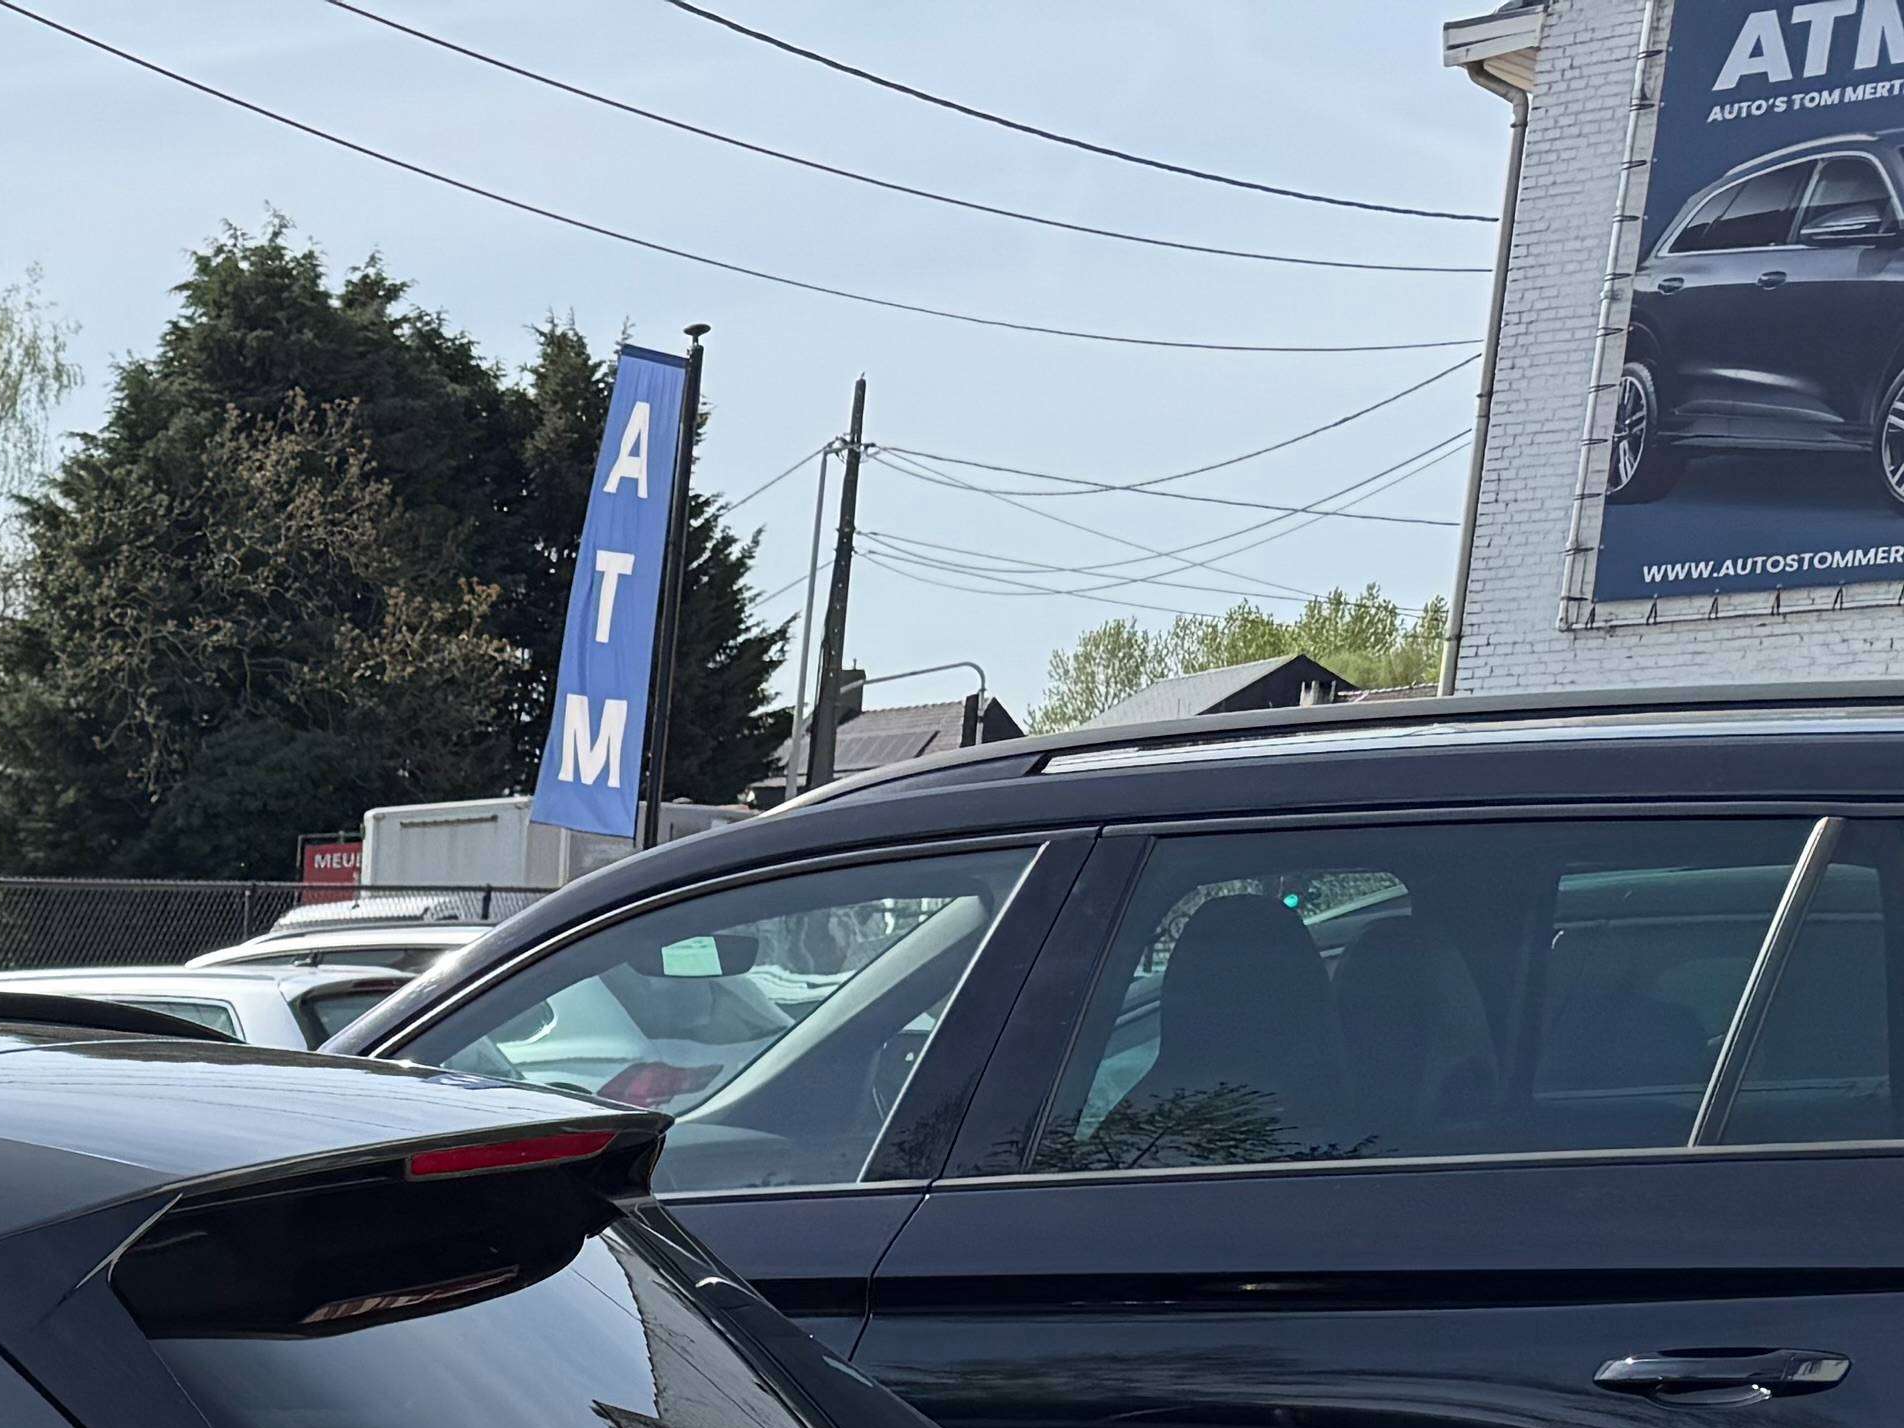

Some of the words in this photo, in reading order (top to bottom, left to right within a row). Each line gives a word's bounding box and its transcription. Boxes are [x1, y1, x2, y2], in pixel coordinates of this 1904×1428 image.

[1706, 97, 1788, 124] AUTO'S
[1792, 88, 1840, 111] TOM
[1843, 78, 1904, 103] MERT
[558, 401, 650, 789] ATM
